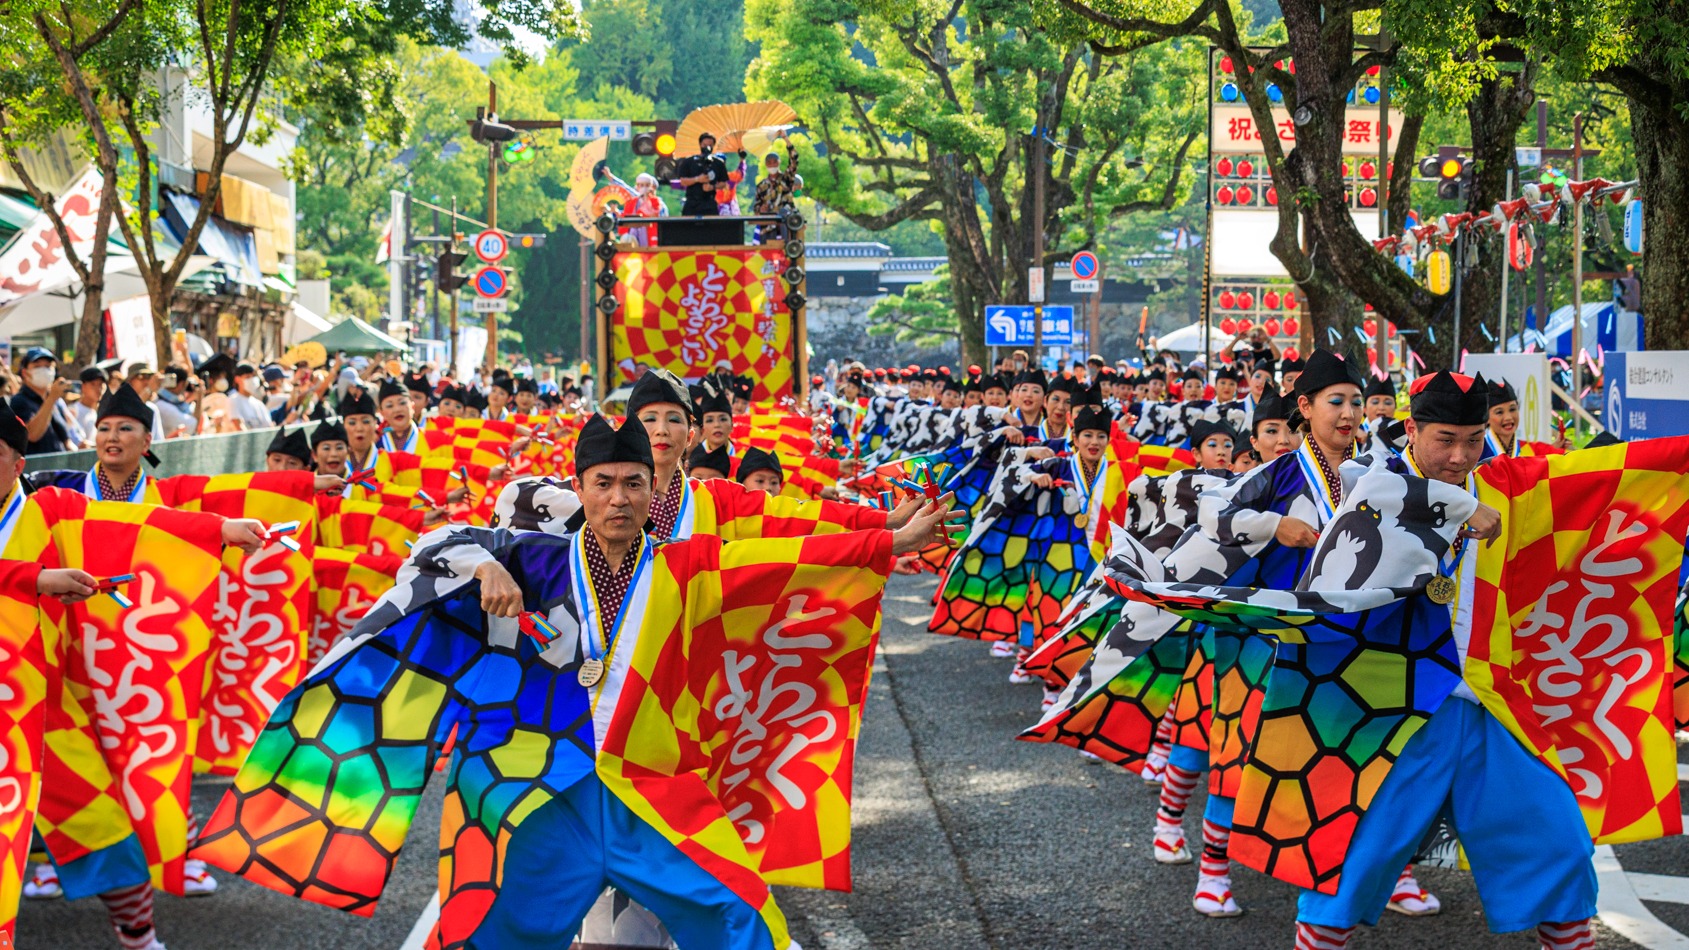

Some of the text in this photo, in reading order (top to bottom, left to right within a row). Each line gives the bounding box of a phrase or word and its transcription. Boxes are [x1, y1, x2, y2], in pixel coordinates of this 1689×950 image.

[1228, 117, 1392, 143] 祝さ祭り
[483, 239, 500, 254] 40
[700, 263, 728, 351] とらっく
[681, 283, 706, 365] よさこい
[82, 622, 126, 749] よさ
[235, 543, 294, 716] とらっく
[1568, 508, 1653, 761] とらっく
[114, 570, 180, 821] とらっく
[751, 594, 837, 810] とらっく
